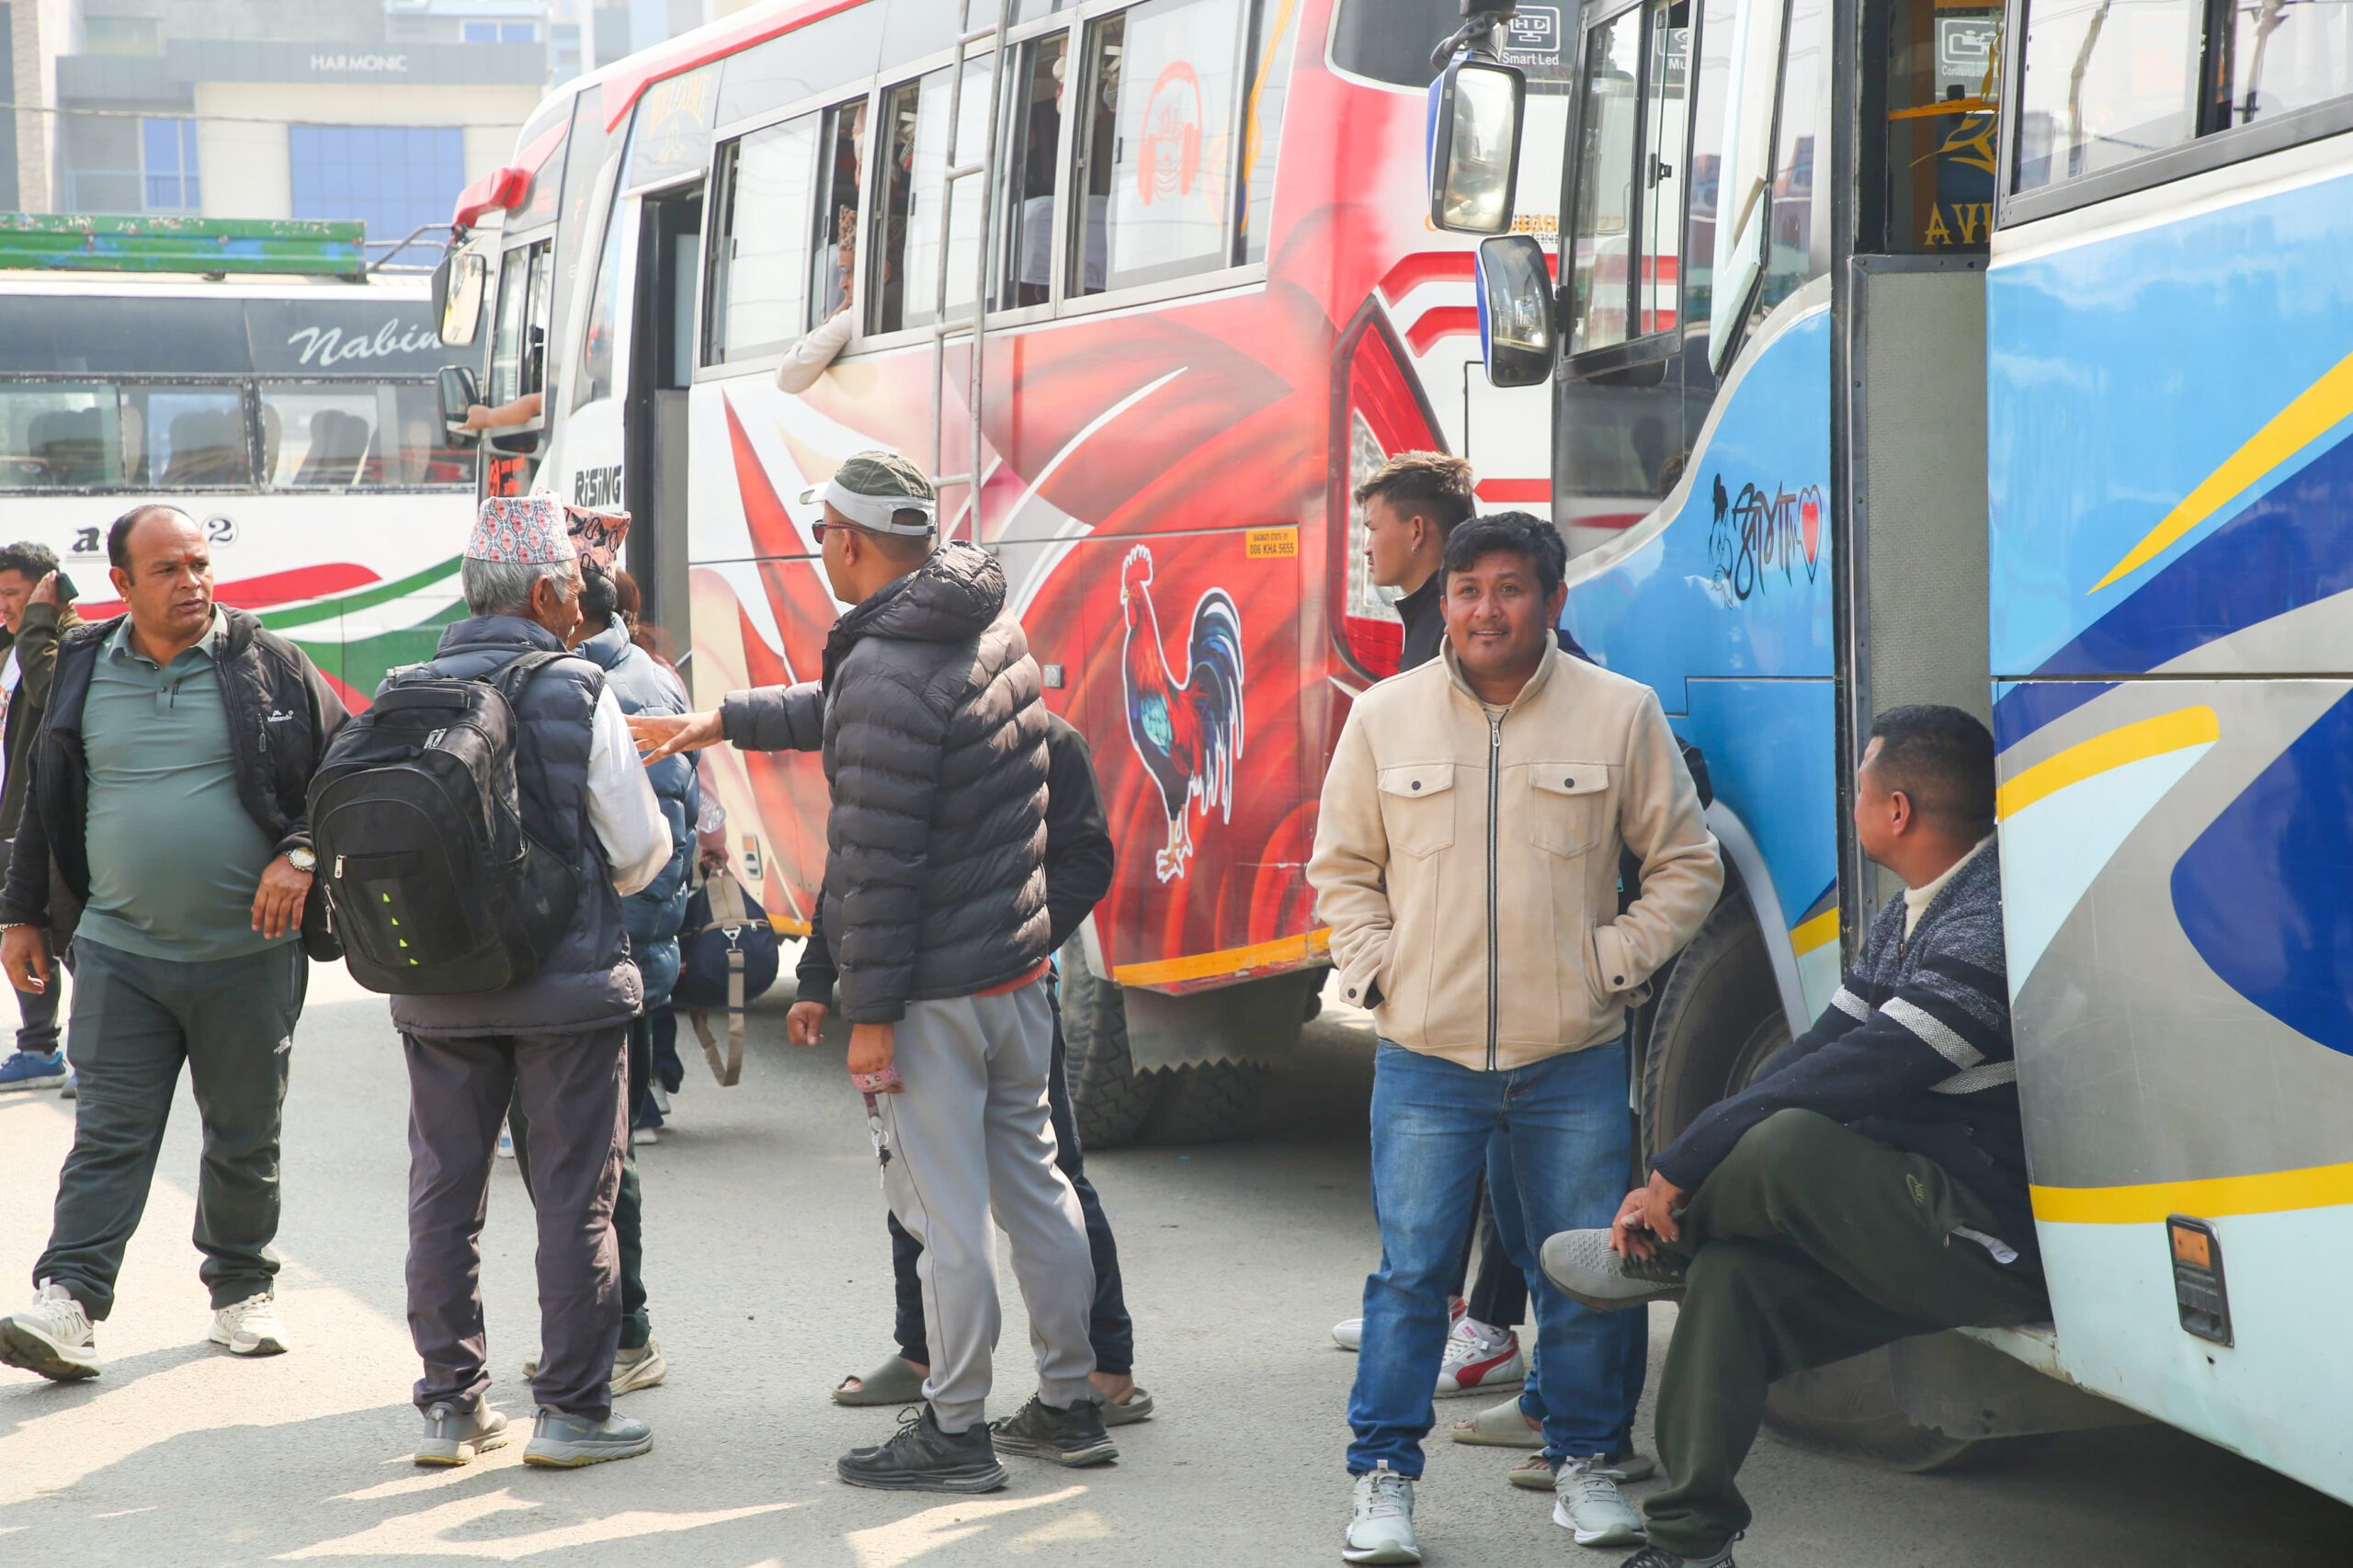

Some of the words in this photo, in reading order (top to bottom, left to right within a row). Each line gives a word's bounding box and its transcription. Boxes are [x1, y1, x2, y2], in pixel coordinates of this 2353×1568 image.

[311, 54, 409, 73] HARMONIC
[1502, 51, 1538, 65] Smart
[1539, 53, 1560, 66] Led
[1263, 543, 1278, 554] KHA
